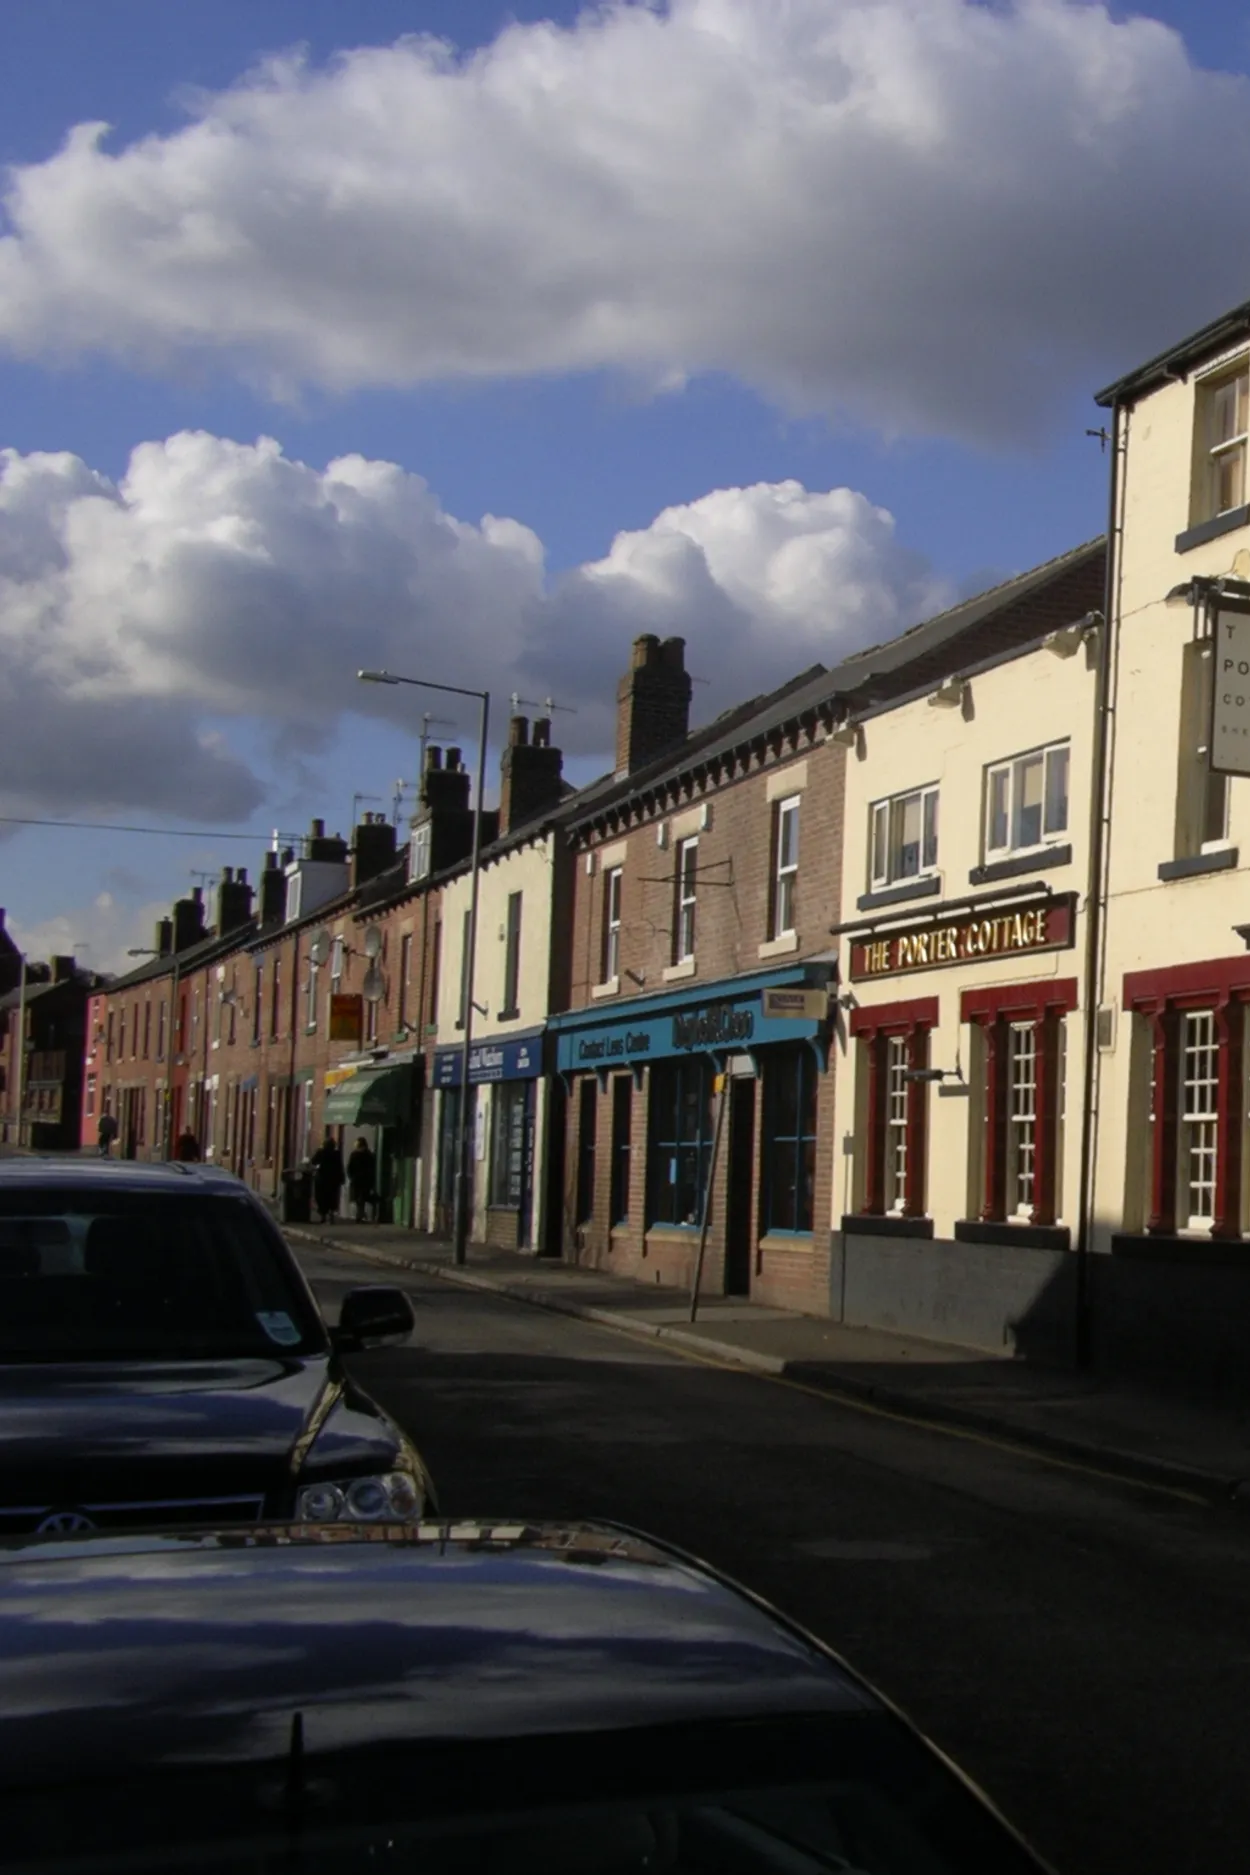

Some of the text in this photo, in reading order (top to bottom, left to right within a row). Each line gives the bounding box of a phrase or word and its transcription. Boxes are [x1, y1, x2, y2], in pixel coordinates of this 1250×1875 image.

[863, 909, 1047, 973] THE PORTER COTTAGE
